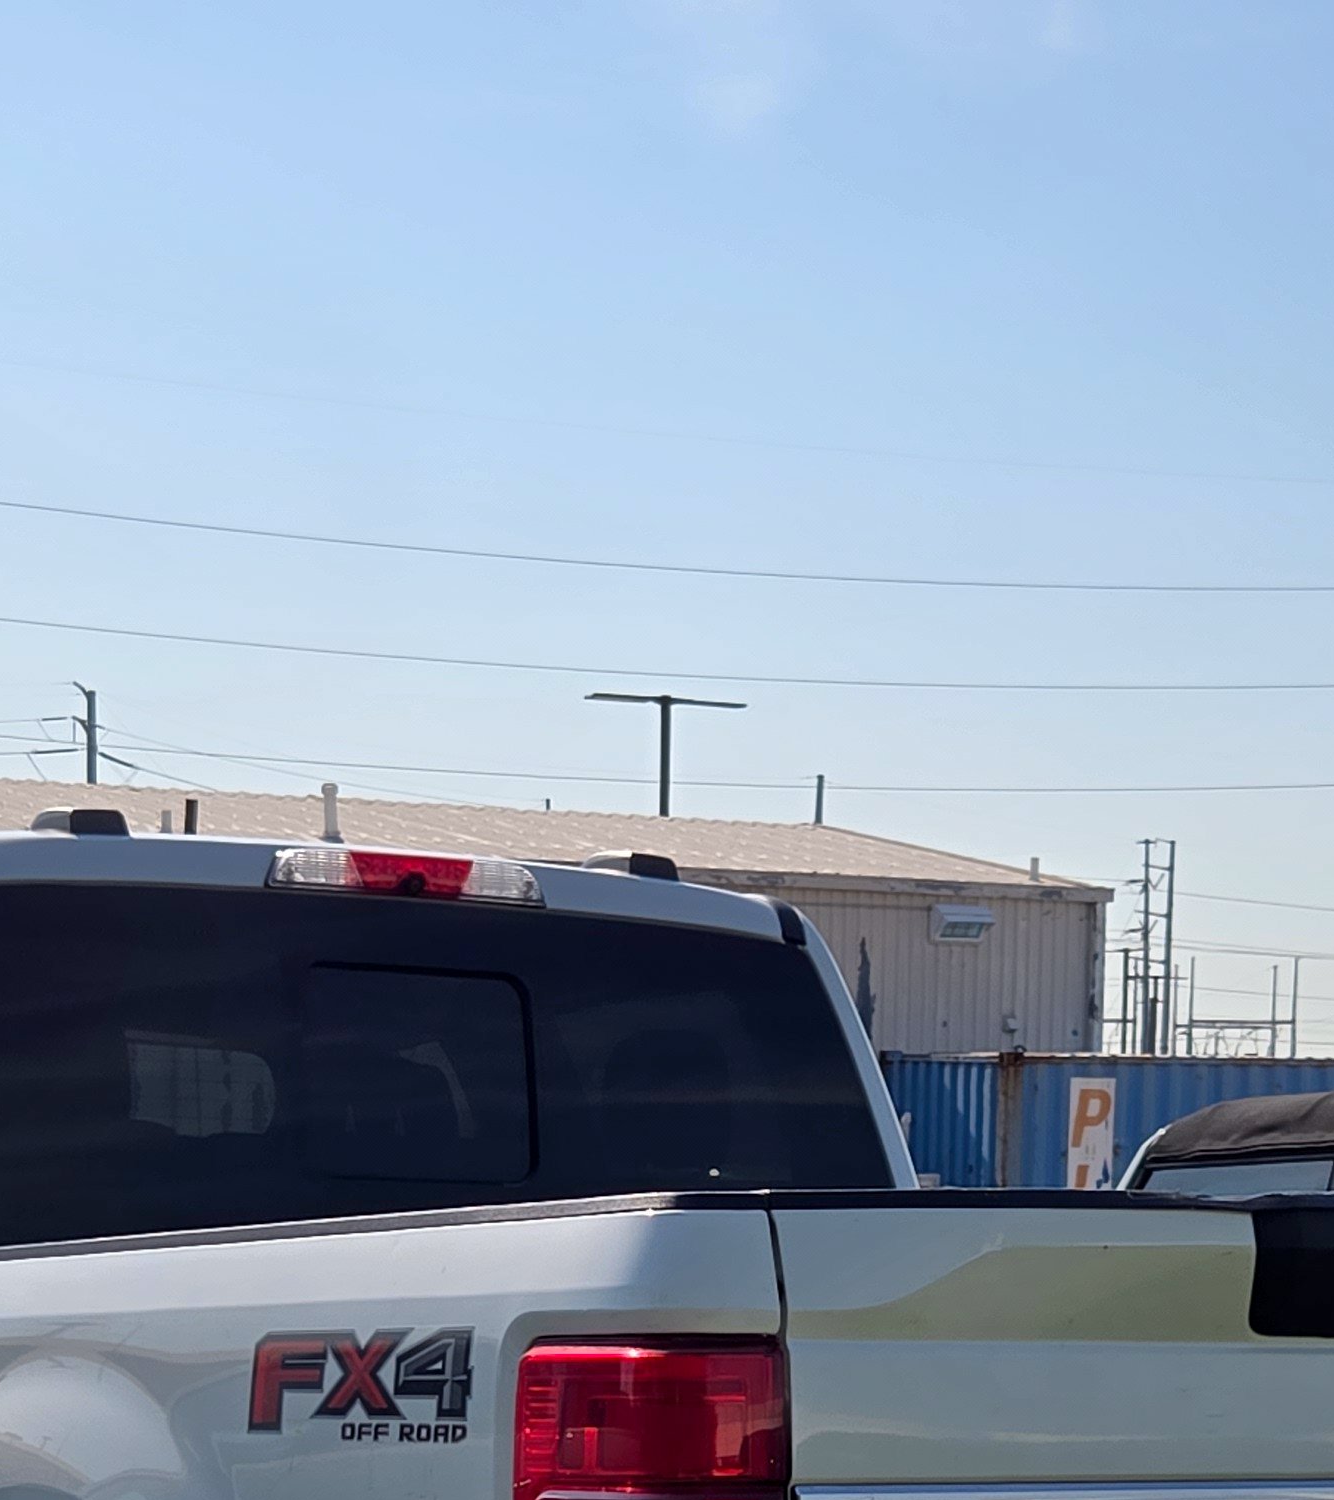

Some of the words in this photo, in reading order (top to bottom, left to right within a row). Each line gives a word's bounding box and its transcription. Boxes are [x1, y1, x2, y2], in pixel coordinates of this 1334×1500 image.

[248, 1326, 475, 1434] FX4
[341, 1423, 390, 1441] OFF
[398, 1424, 468, 1443] ROAD
